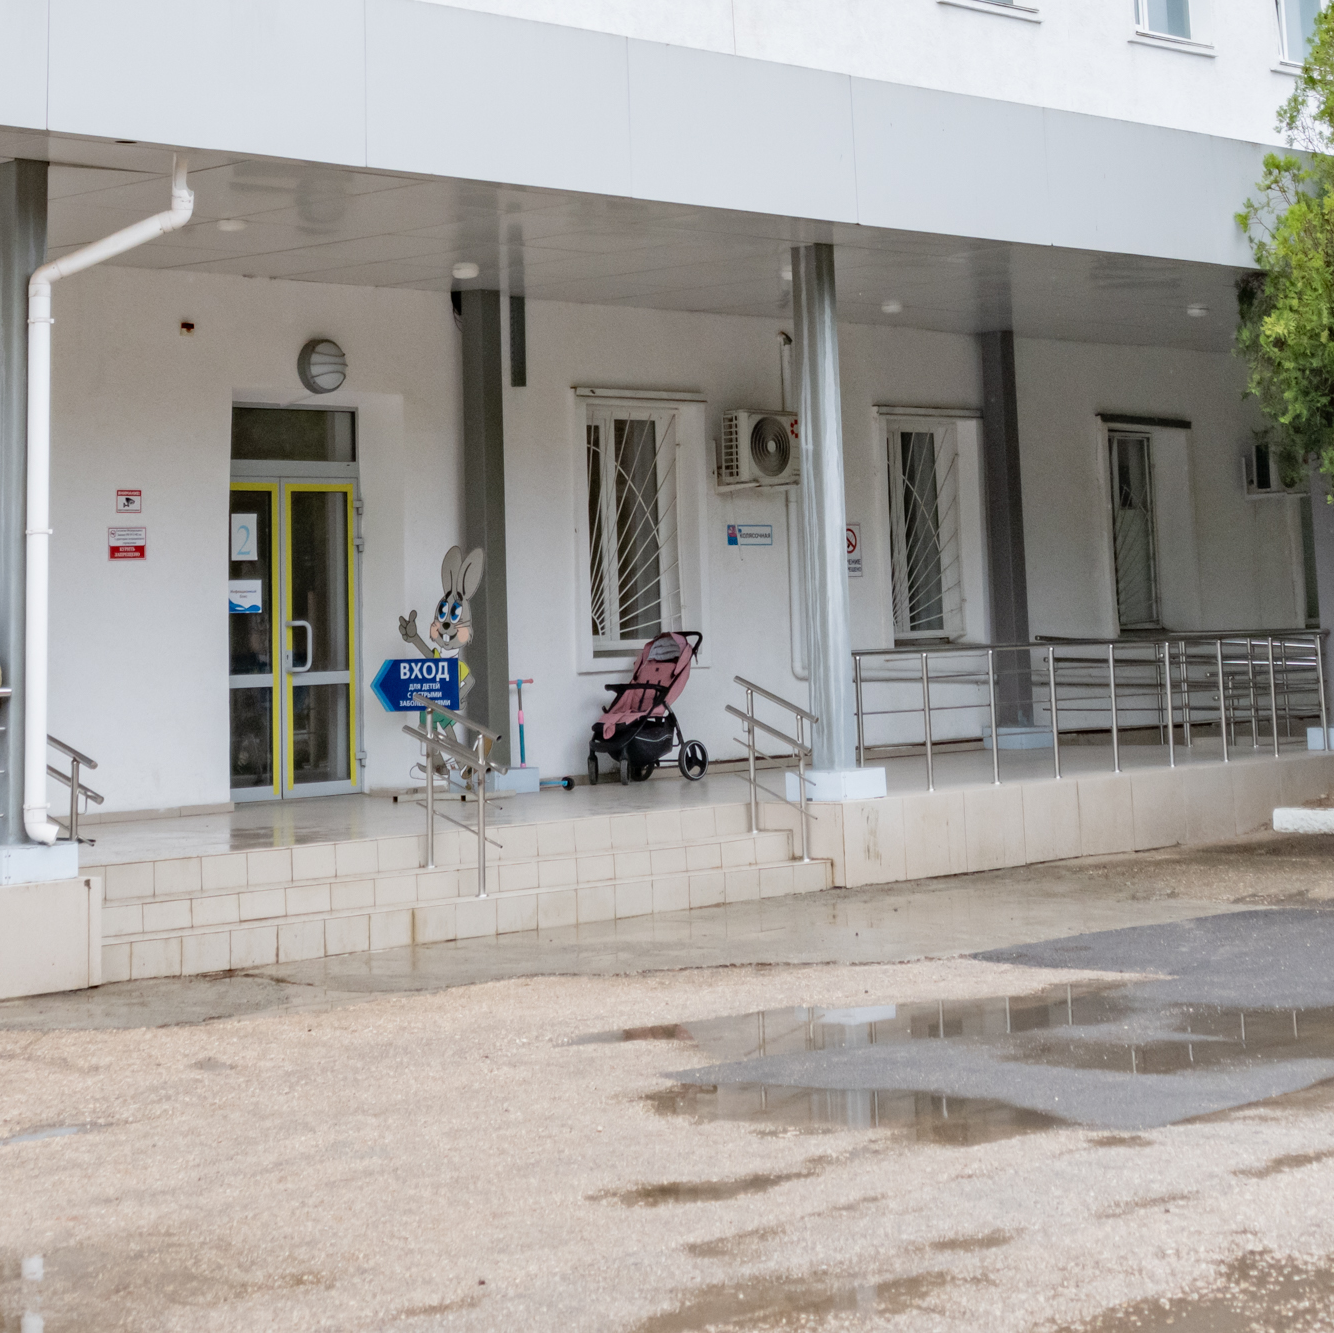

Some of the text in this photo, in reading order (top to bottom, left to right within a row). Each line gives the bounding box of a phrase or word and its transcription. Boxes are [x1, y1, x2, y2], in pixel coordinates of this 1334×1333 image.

[236, 524, 251, 556] 2
[400, 662, 450, 681] ВХОД
[422, 682, 441, 690] ДЕТЕЙ
